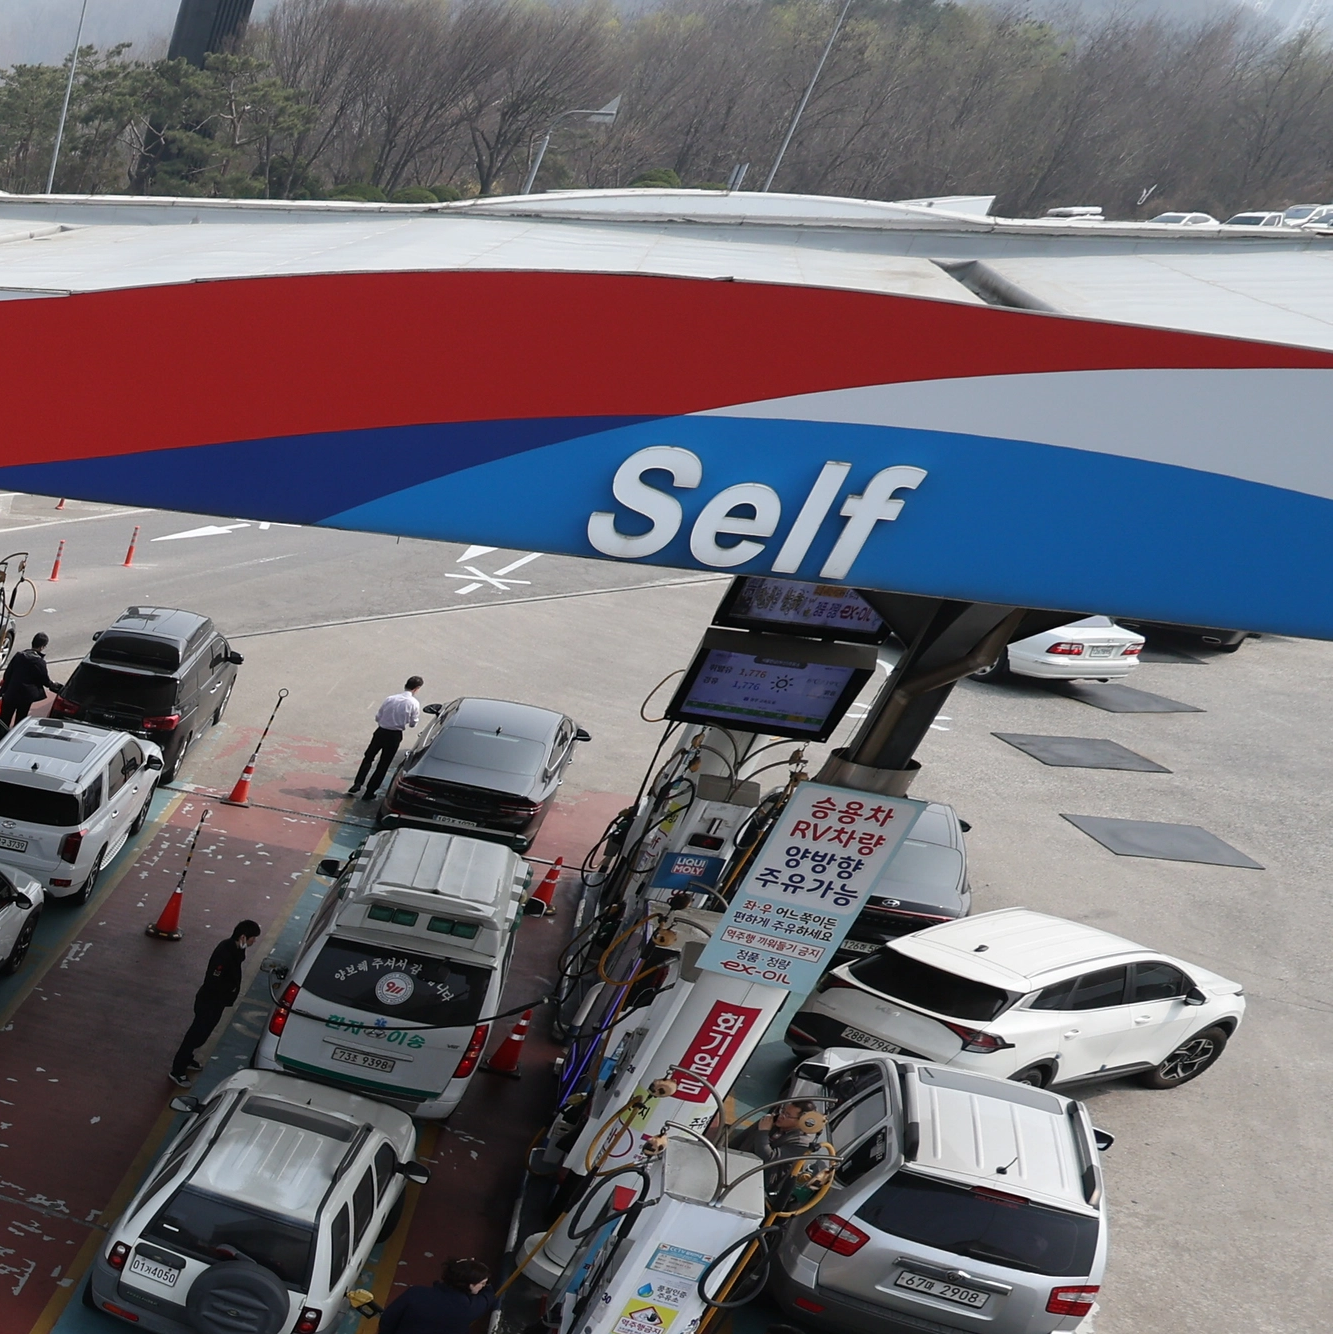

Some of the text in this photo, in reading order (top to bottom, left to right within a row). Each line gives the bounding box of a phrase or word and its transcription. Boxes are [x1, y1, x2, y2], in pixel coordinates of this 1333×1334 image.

[587, 444, 929, 580] Self
[739, 668, 767, 679] 1,776
[811, 797, 894, 828] 승용차
[7, 841, 25, 850] 3739
[789, 820, 886, 856] RV차량
[673, 865, 704, 875] MOLY
[676, 857, 707, 868] LIQUI
[785, 846, 865, 880] 양방향
[755, 867, 859, 907] 주유가능
[733, 911, 833, 942] 편하게 주유하세요
[776, 907, 837, 930] 어느쪽이든
[727, 929, 821, 959] 역주행 끼워들기 금지
[736, 949, 791, 971] 정품 정량
[334, 960, 369, 981] 양보해
[371, 957, 408, 970] 주셔서
[410, 963, 455, 1002] 감니다
[720, 960, 791, 985] ex-OIL
[384, 981, 405, 995] 911
[387, 1030, 426, 1049] 이송
[870, 1039, 897, 1054] 7964
[363, 1054, 388, 1070] 9398
[676, 1011, 745, 1096] 화기엄금
[601, 1292, 612, 1304] 30
[657, 1284, 688, 1299] 품질인증
[657, 1293, 680, 1304] 주유소
[939, 1285, 980, 1304] 2908
[621, 1318, 662, 1334] 역주행금지
